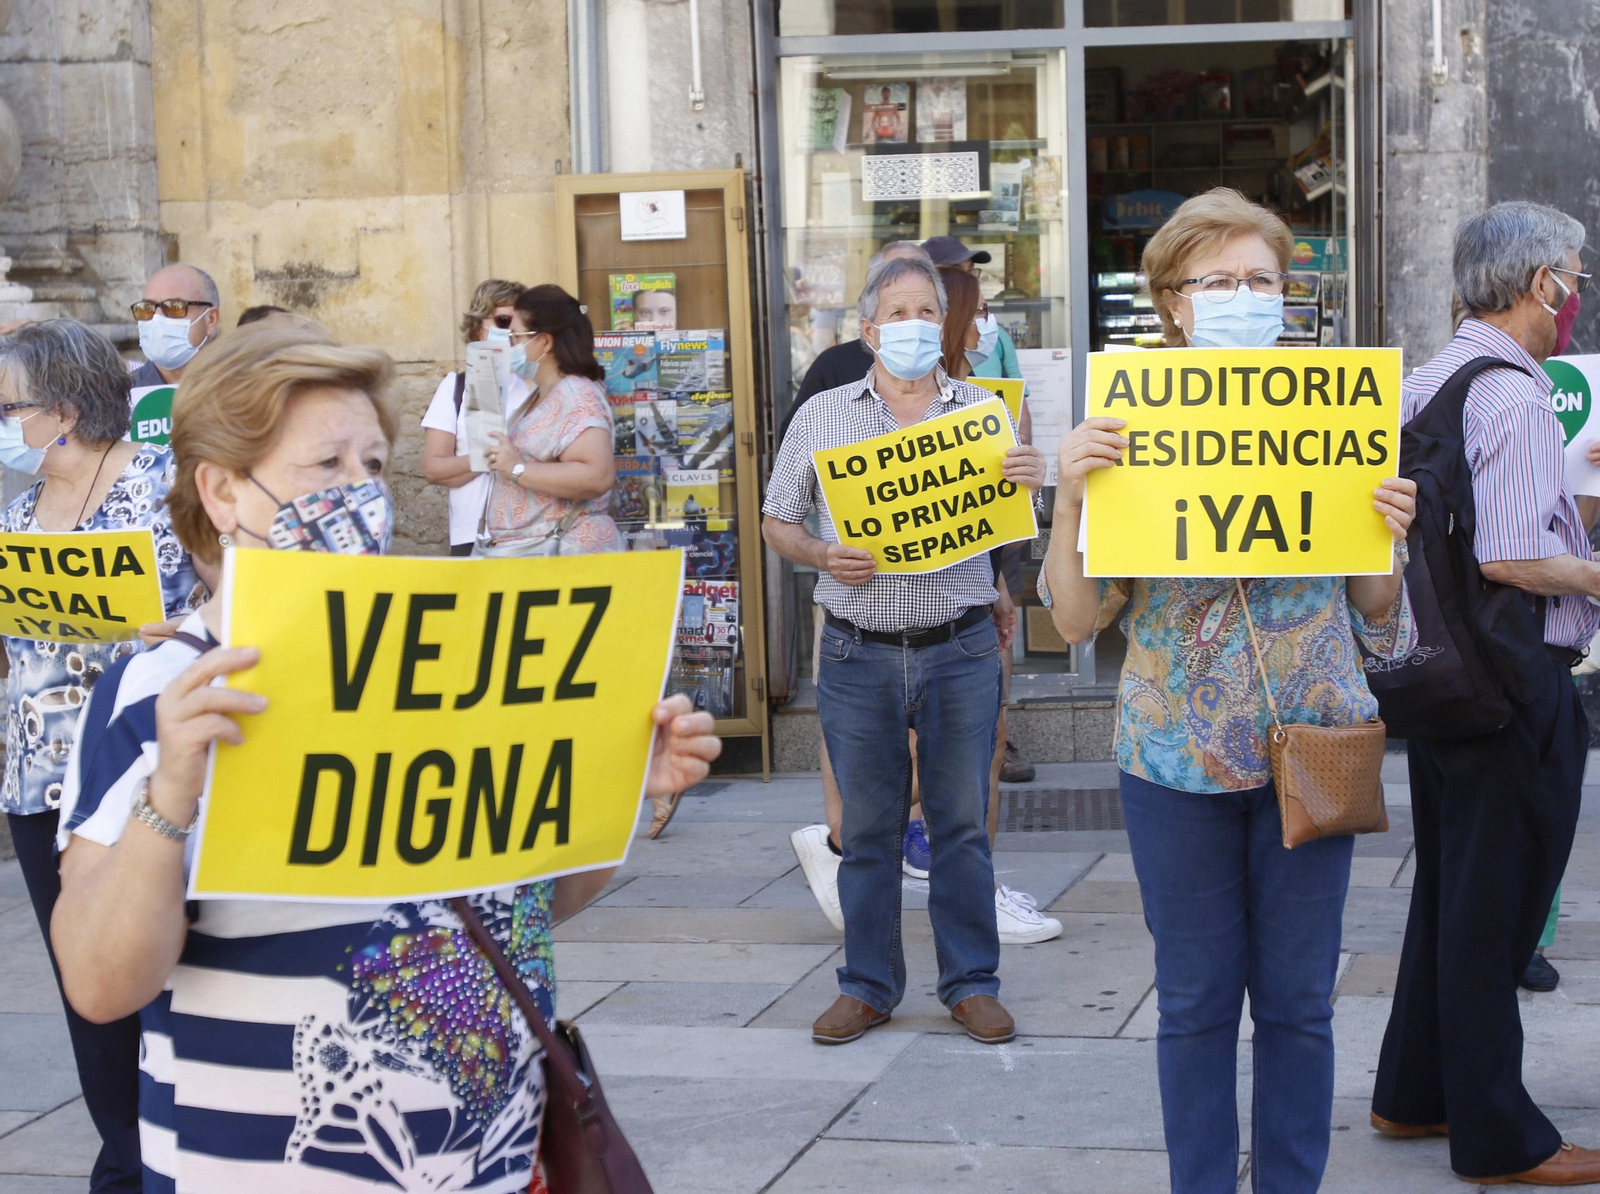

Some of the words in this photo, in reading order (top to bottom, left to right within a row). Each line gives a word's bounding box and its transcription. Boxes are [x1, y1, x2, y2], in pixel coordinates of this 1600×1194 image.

[622, 281, 639, 293] Love
[640, 279, 673, 291] English
[622, 336, 655, 348] REVUE
[1103, 366, 1382, 408] AUDITORIA
[828, 455, 867, 480] LO
[876, 414, 1001, 470] PÚBLICO
[1113, 429, 1389, 467] ESIDENCIAS
[671, 473, 713, 483] CLAVES
[865, 457, 985, 506] IGUALA.
[844, 517, 882, 538] LO
[891, 478, 1018, 533] PRIVADO
[1175, 490, 1313, 561] ¡YA!
[622, 530, 653, 540] Cerebro
[883, 517, 994, 563] SEPARA
[14, 615, 101, 639] ¡YA!
[325, 585, 613, 712] VEJEZ
[286, 738, 573, 867] DIGNA
